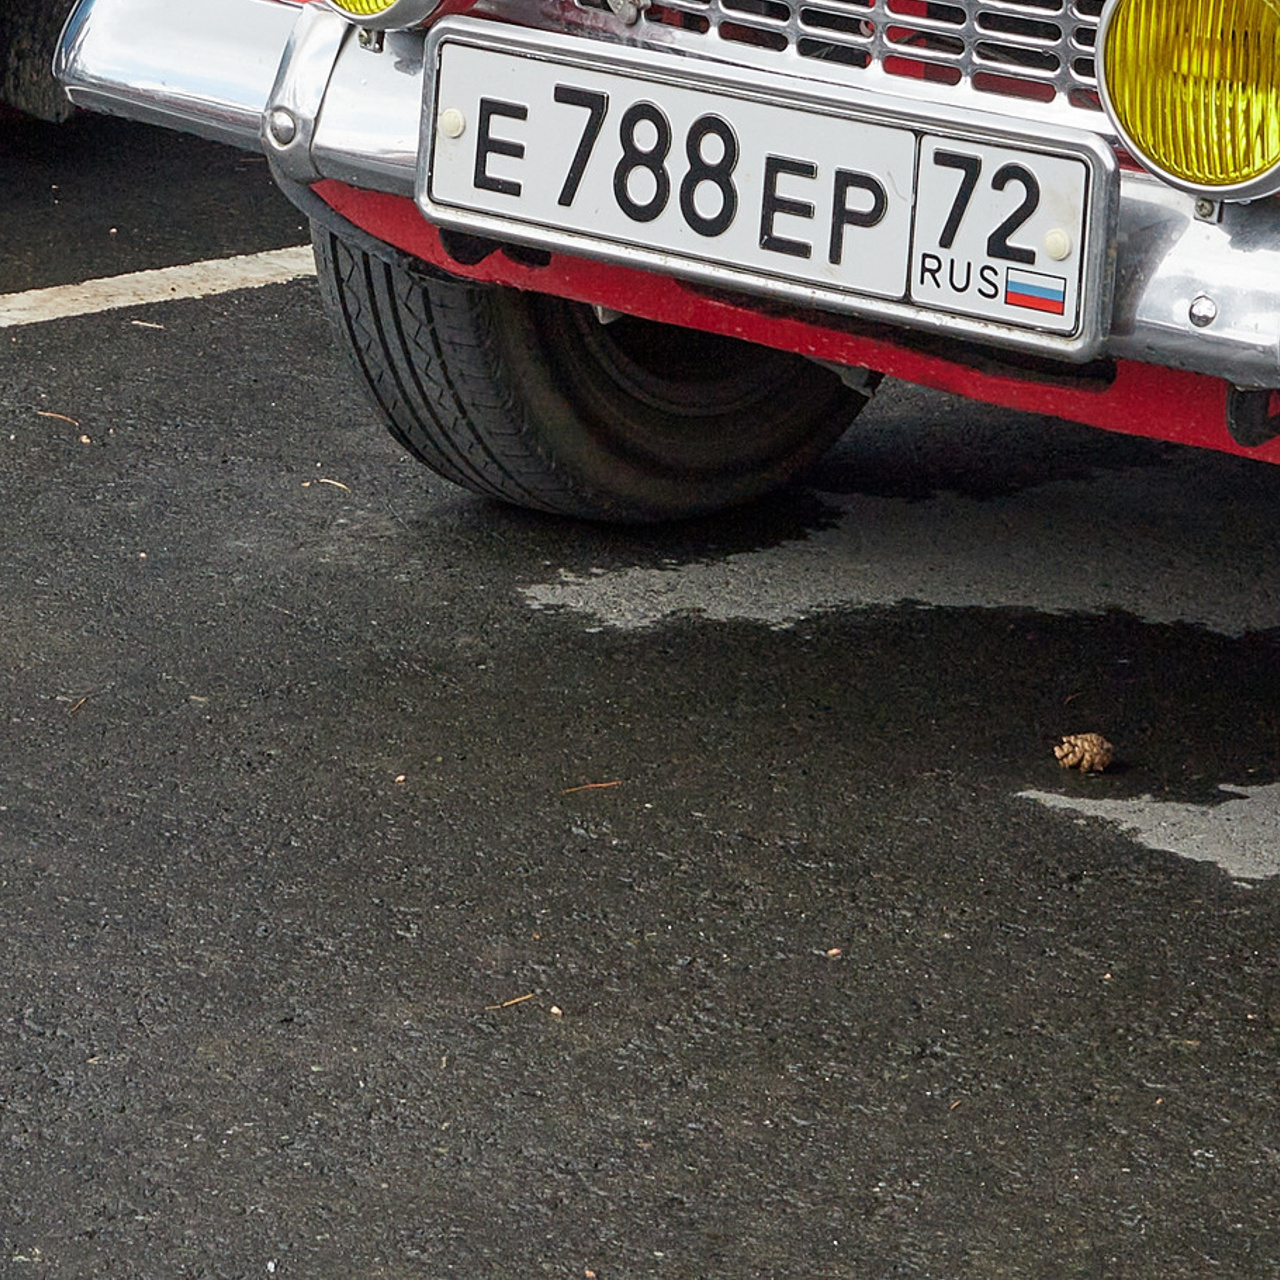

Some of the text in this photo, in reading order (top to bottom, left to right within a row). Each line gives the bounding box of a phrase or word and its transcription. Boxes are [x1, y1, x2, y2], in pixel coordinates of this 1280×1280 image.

[473, 84, 889, 265] Е788ЕР
[931, 149, 1042, 265] 72
[920, 252, 999, 299] RUS
